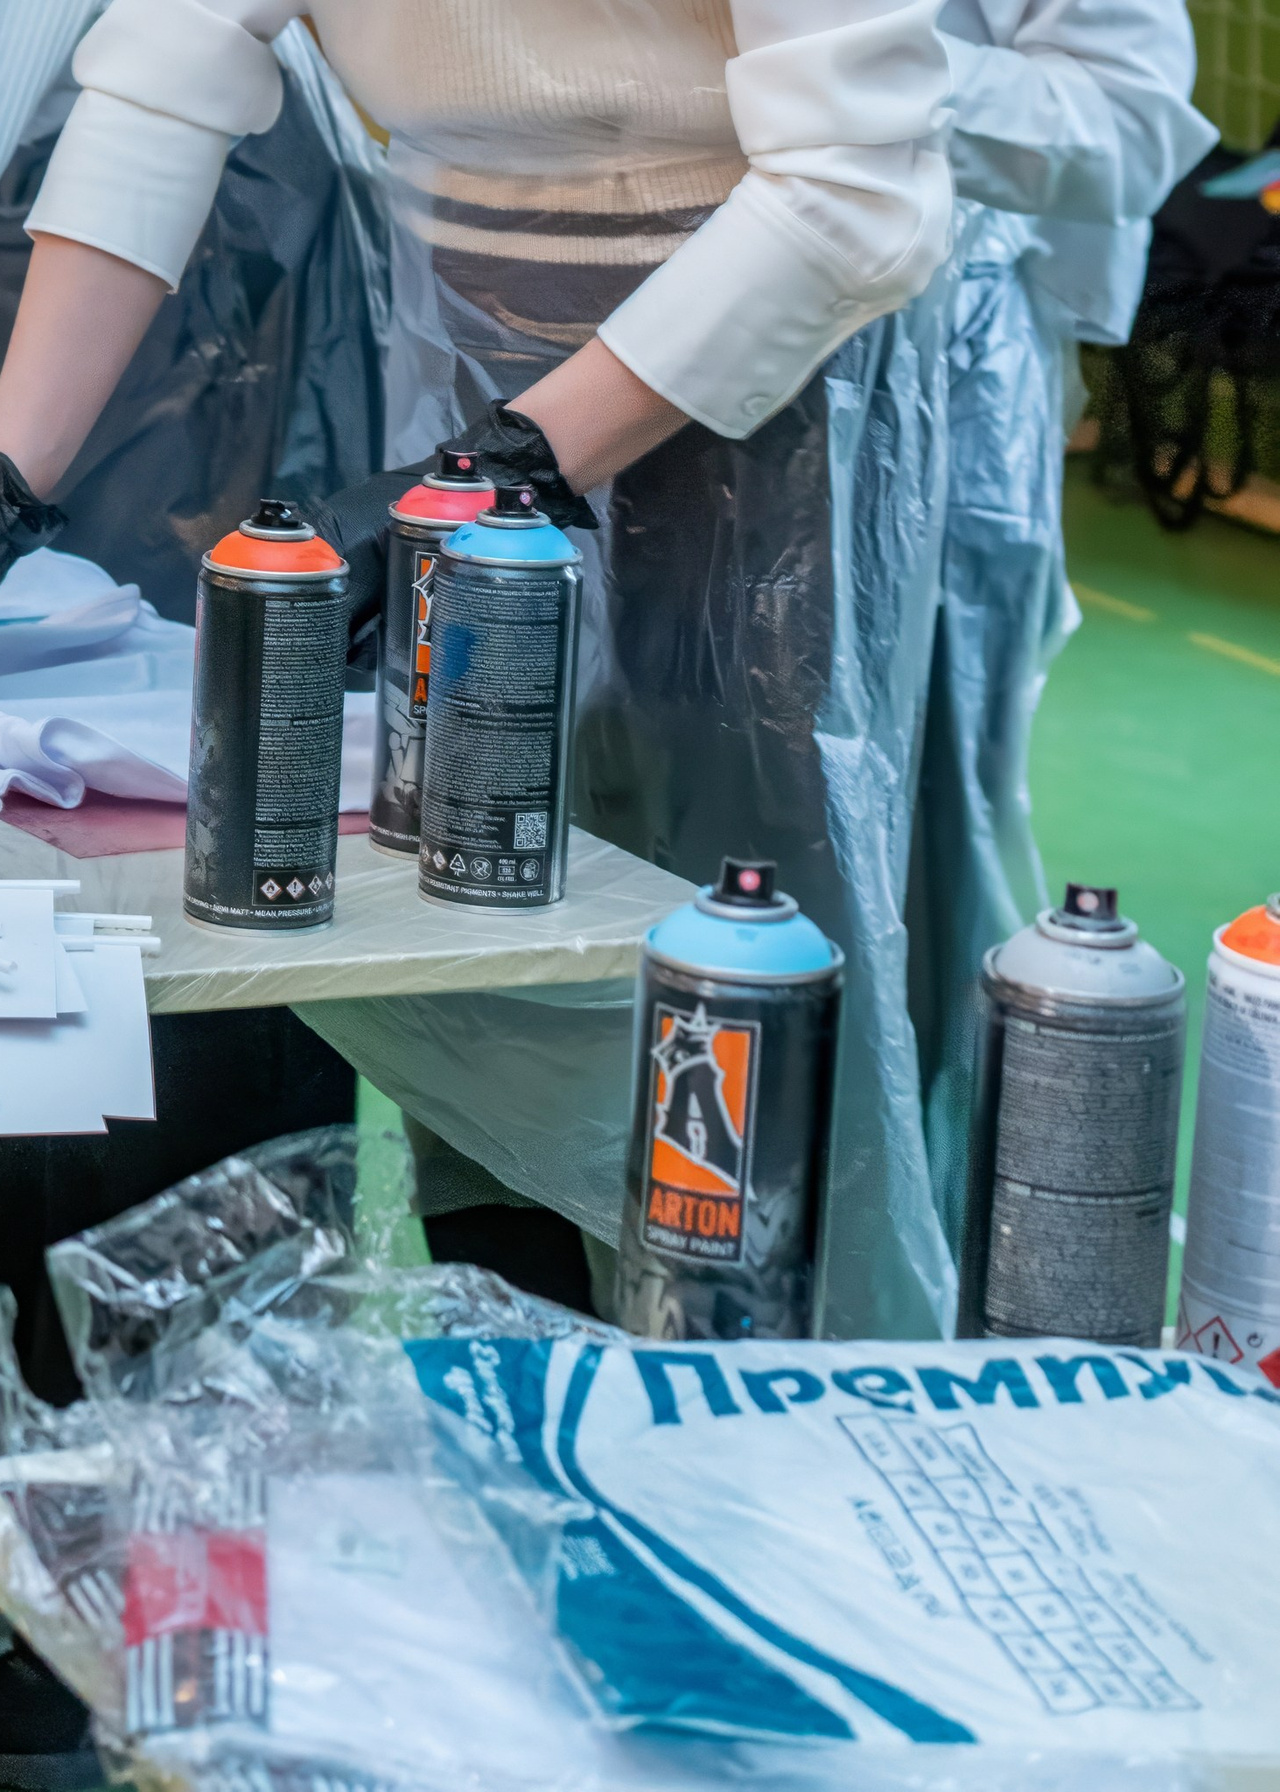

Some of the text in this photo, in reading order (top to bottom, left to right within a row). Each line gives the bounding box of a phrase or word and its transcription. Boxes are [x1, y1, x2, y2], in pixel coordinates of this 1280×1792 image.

[460, 886, 497, 897] PIGMENTS
[230, 905, 250, 916] MATT
[277, 907, 313, 918] PRESSURE
[648, 1187, 740, 1237] ARTON
[646, 1224, 737, 1257] SPRAY PAINT
